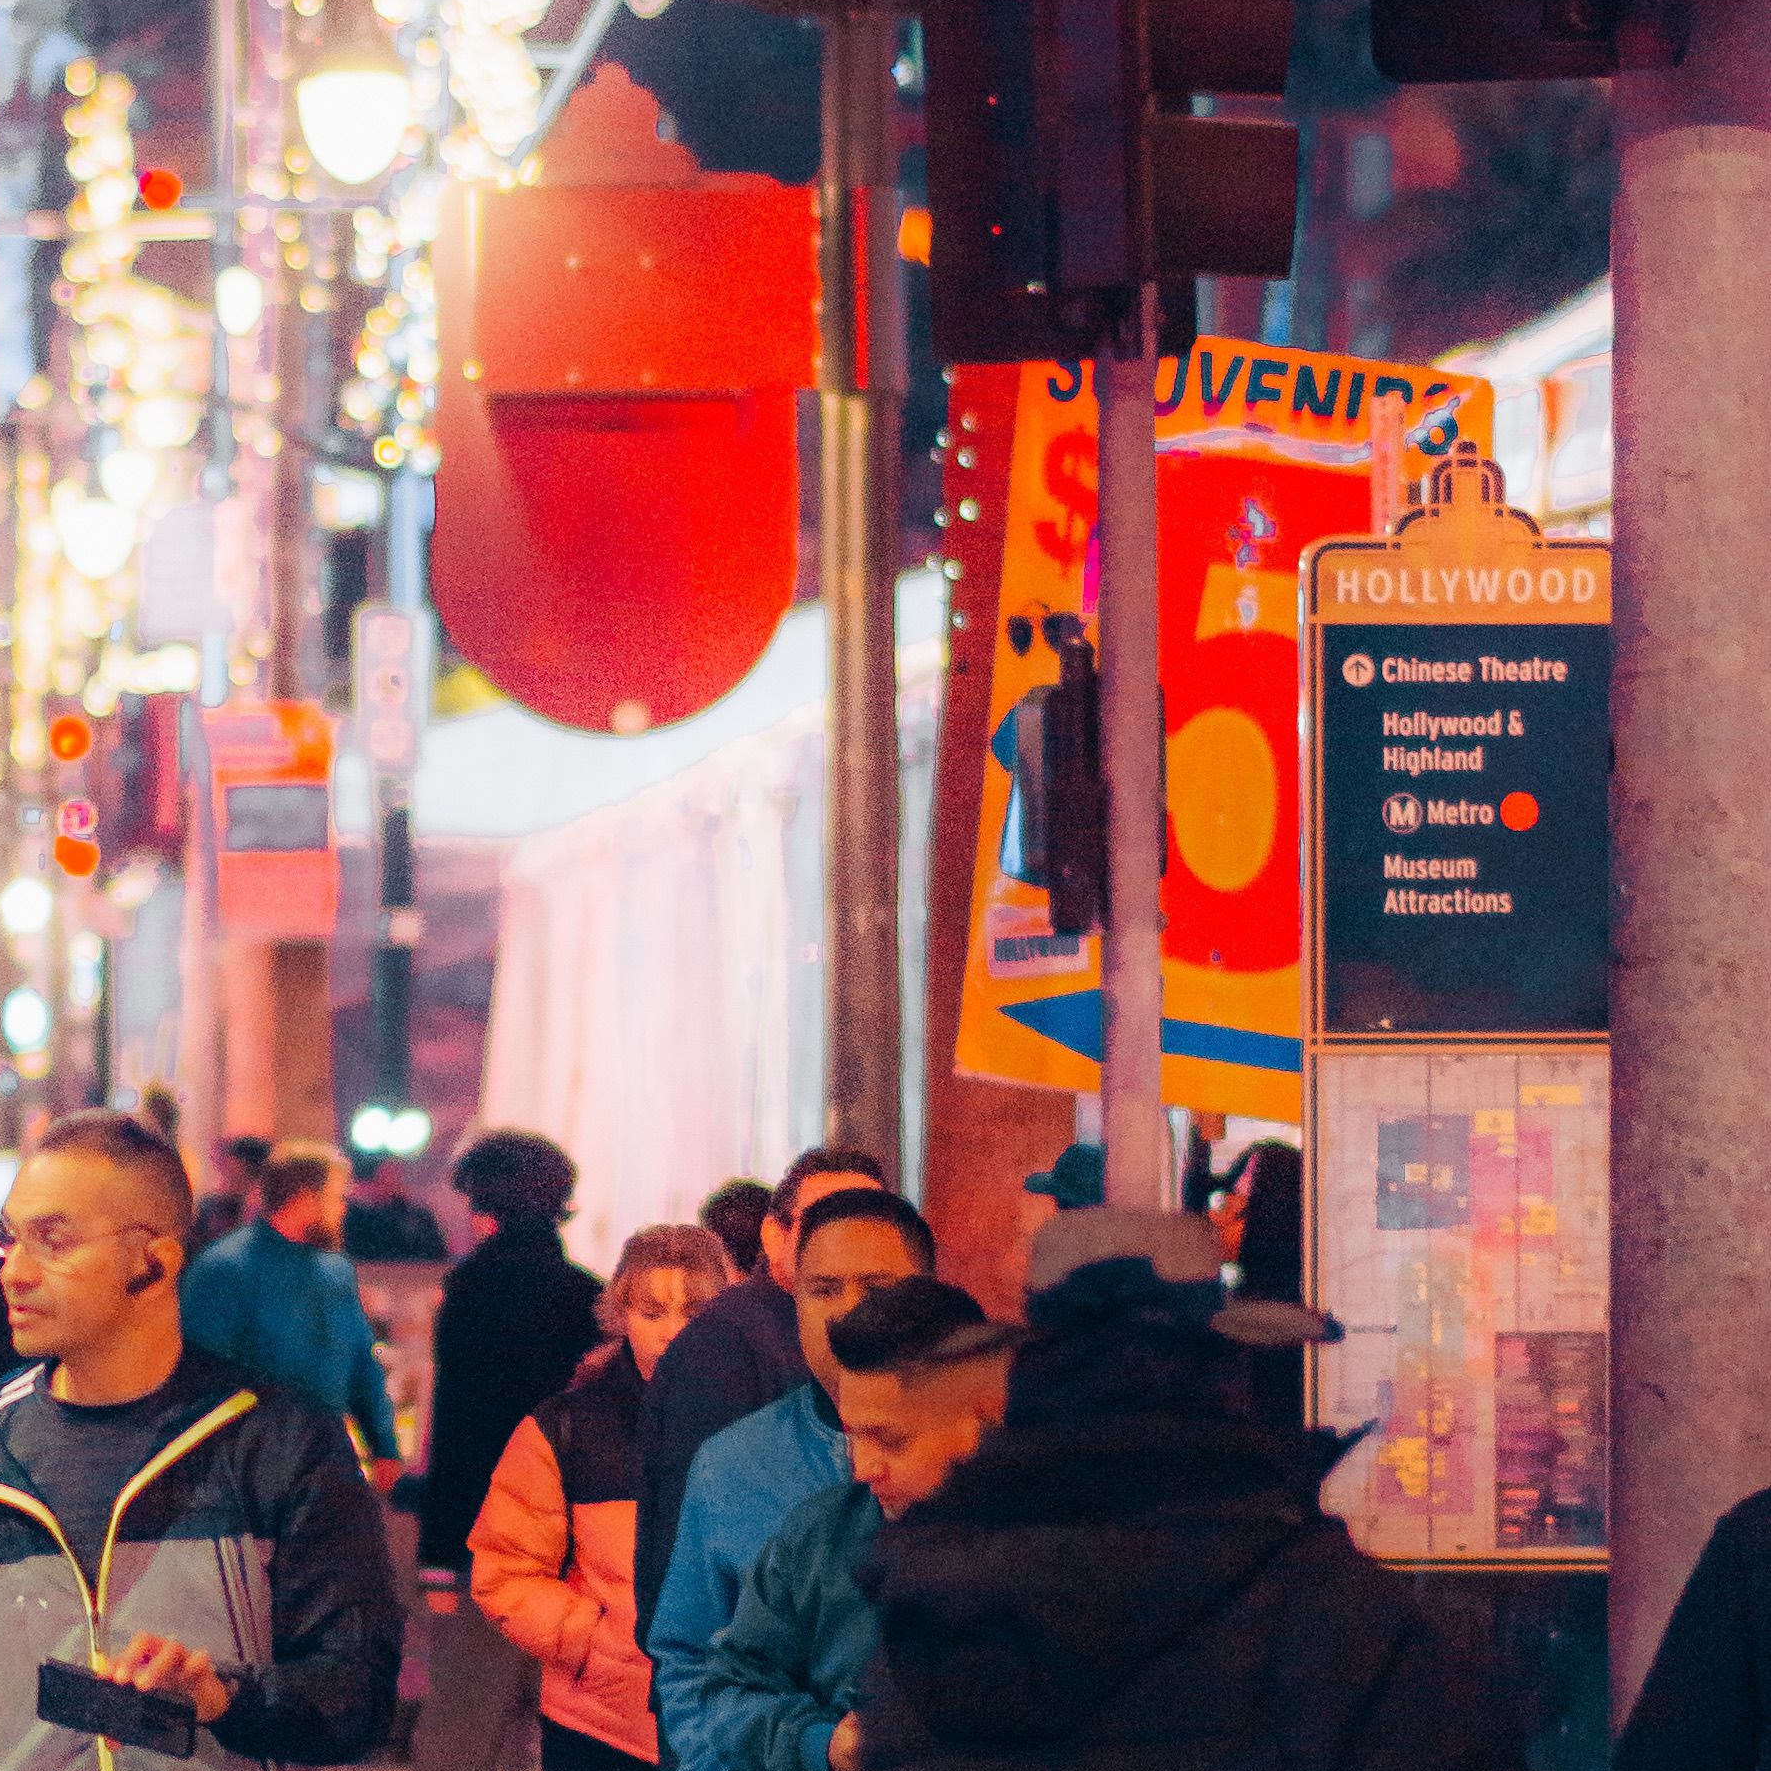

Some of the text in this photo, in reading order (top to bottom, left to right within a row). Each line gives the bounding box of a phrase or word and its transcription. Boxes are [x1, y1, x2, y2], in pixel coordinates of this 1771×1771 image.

[1335, 567, 1596, 604] HOLLYWOOD
[1381, 655, 1569, 683] Chinese Theatre
[1382, 708, 1525, 742] Hollywood &
[1382, 745, 1484, 777] Highland
[1427, 799, 1495, 826] Metro
[1383, 853, 1478, 879] Museum
[1383, 887, 1514, 915] Attractions
